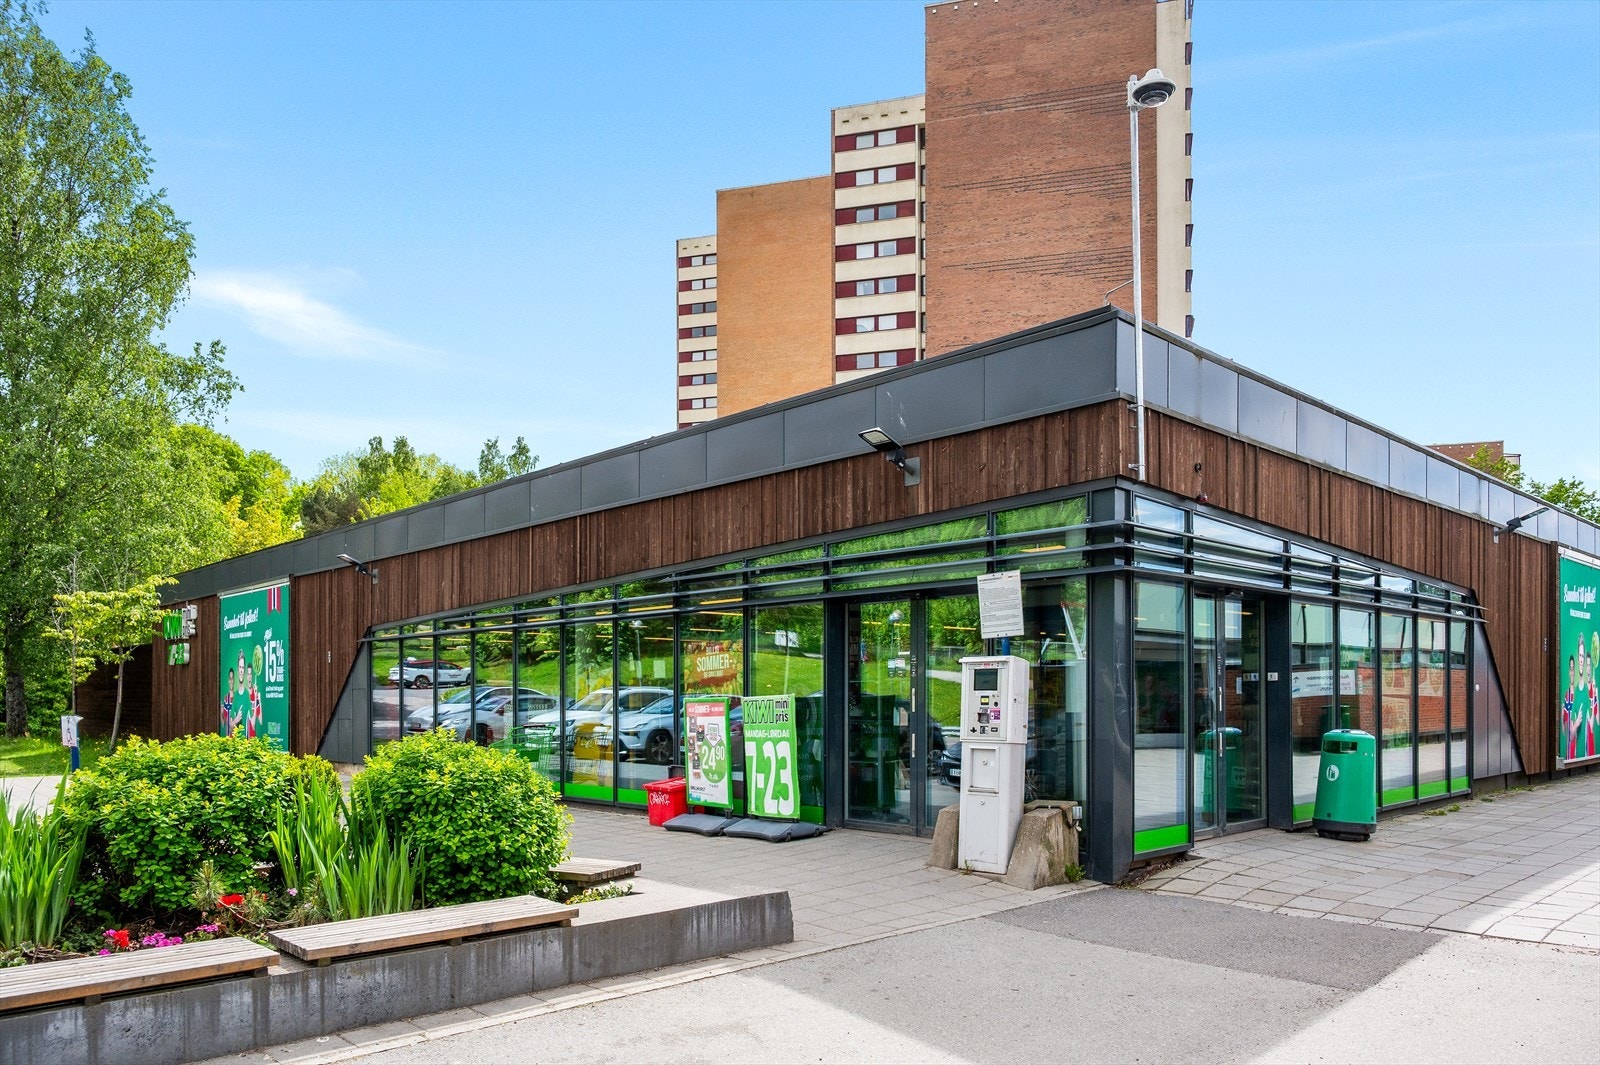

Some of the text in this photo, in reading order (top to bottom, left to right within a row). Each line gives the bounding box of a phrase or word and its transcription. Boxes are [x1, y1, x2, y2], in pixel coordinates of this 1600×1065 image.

[696, 653, 733, 672] SOMMER-
[743, 698, 789, 724] KIWI mini
[775, 710, 789, 724] pris
[745, 729, 790, 738] MANDAG-LØRDAG
[745, 740, 794, 815] 7-23
